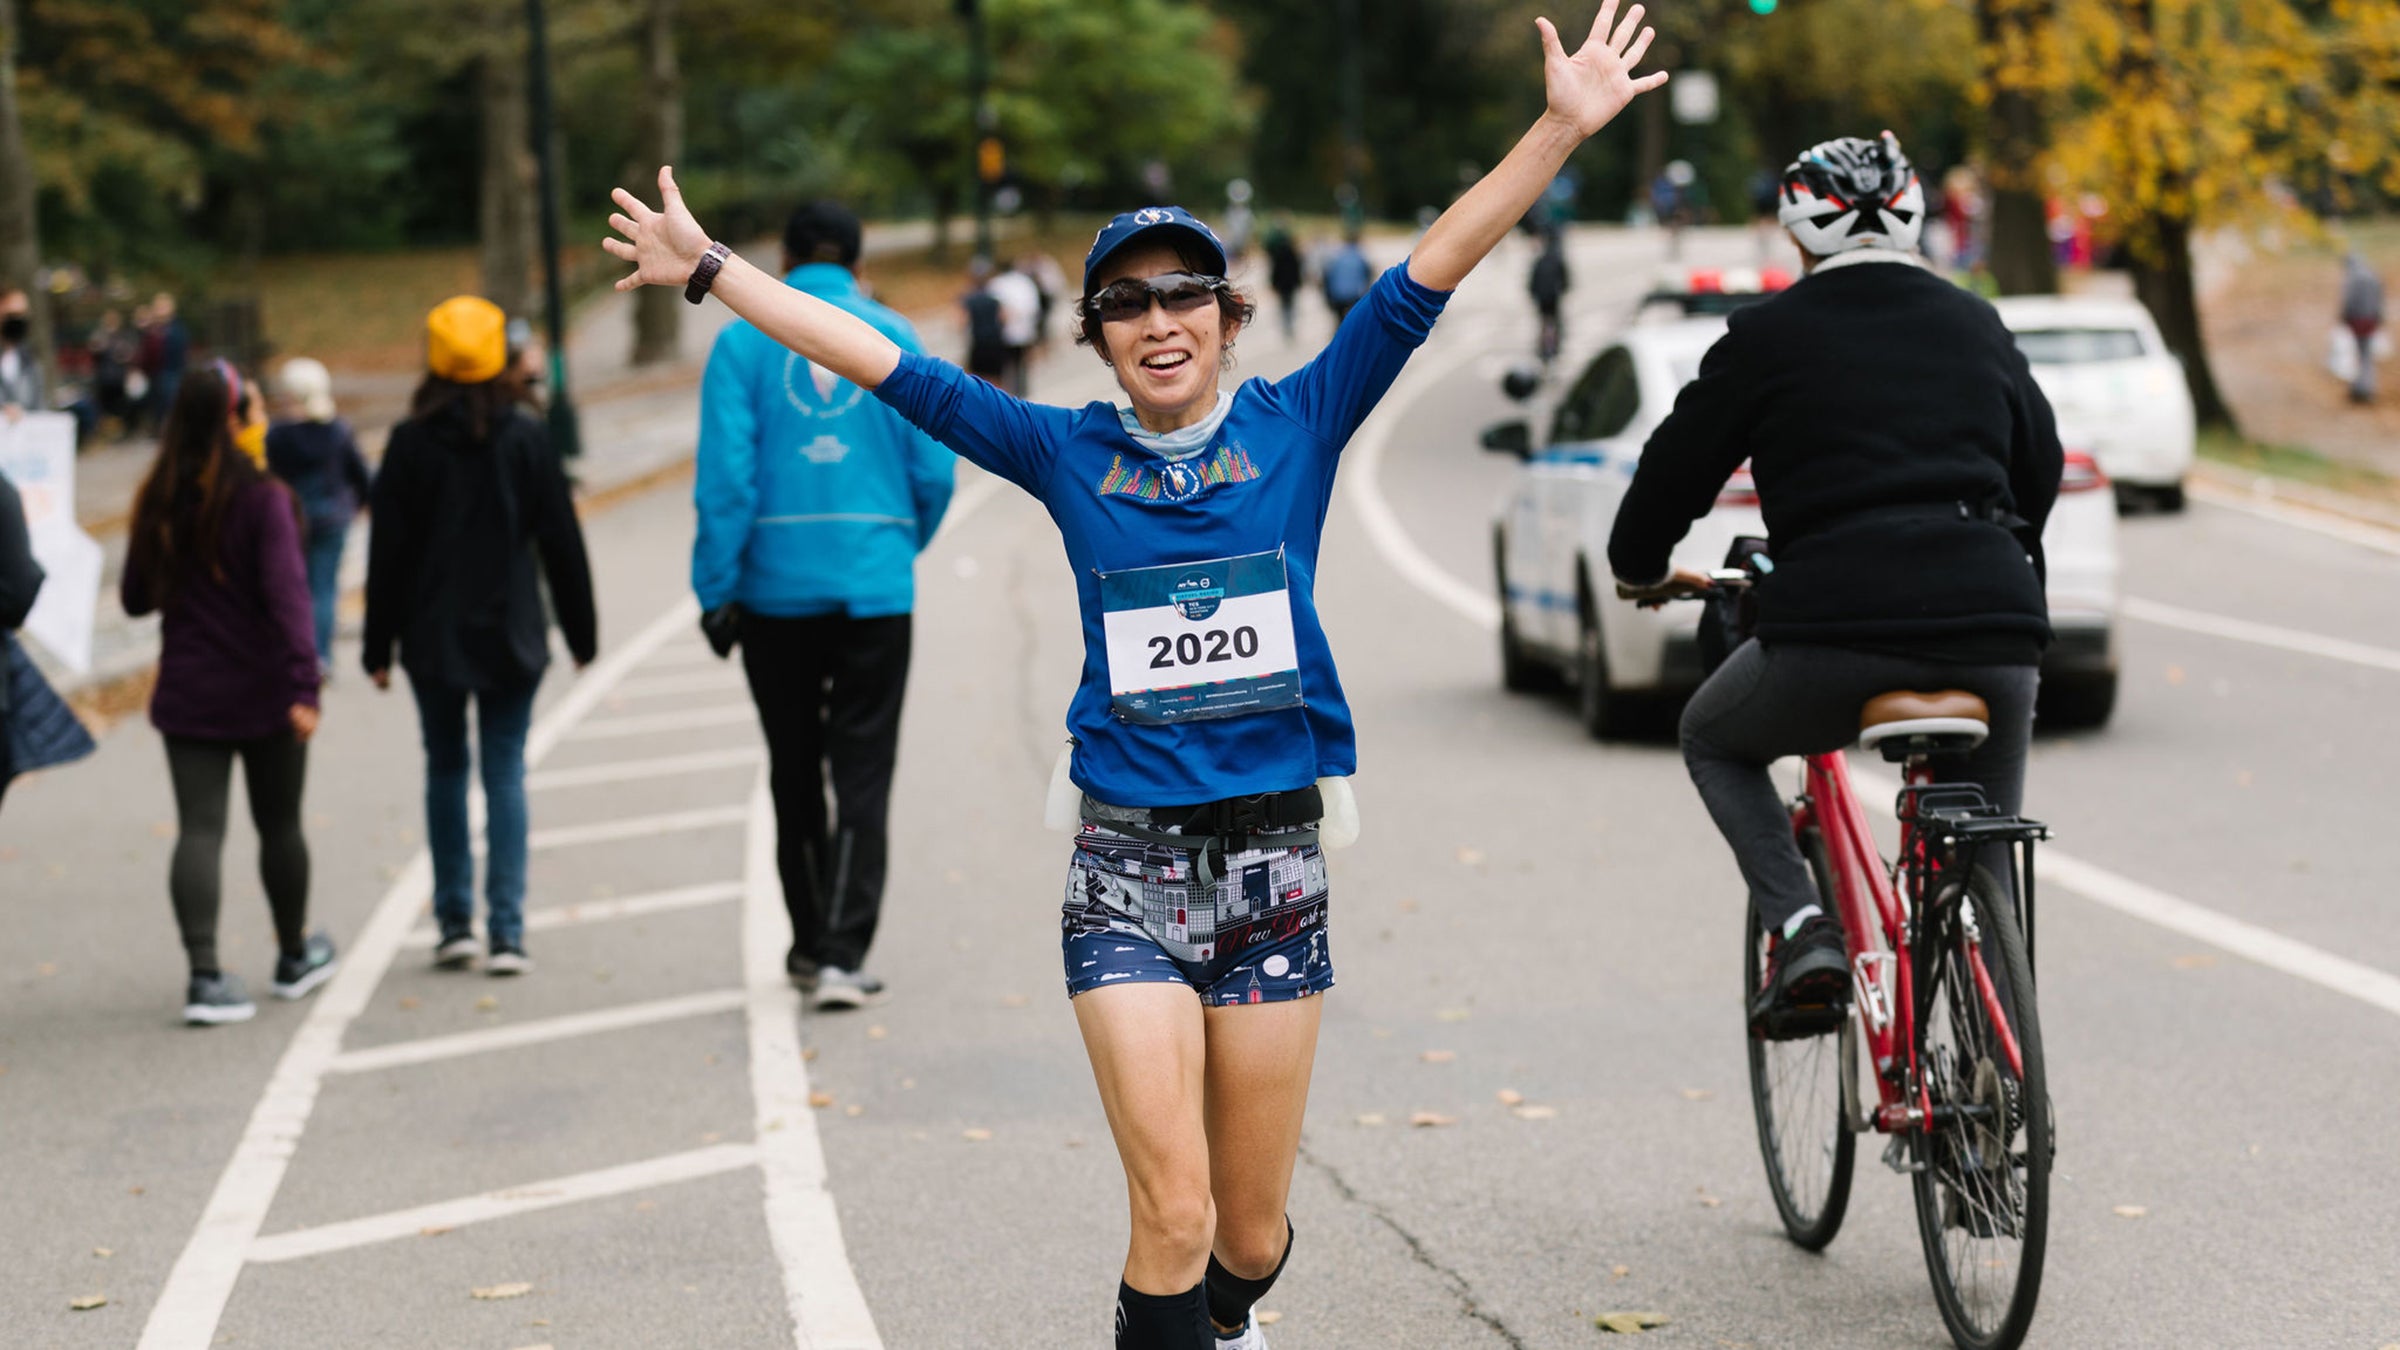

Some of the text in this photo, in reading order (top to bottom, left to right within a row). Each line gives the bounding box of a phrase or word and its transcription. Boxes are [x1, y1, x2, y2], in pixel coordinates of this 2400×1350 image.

[1148, 625, 1259, 670] 2020
[1217, 924, 1272, 953] New
[1272, 905, 1319, 942] York
